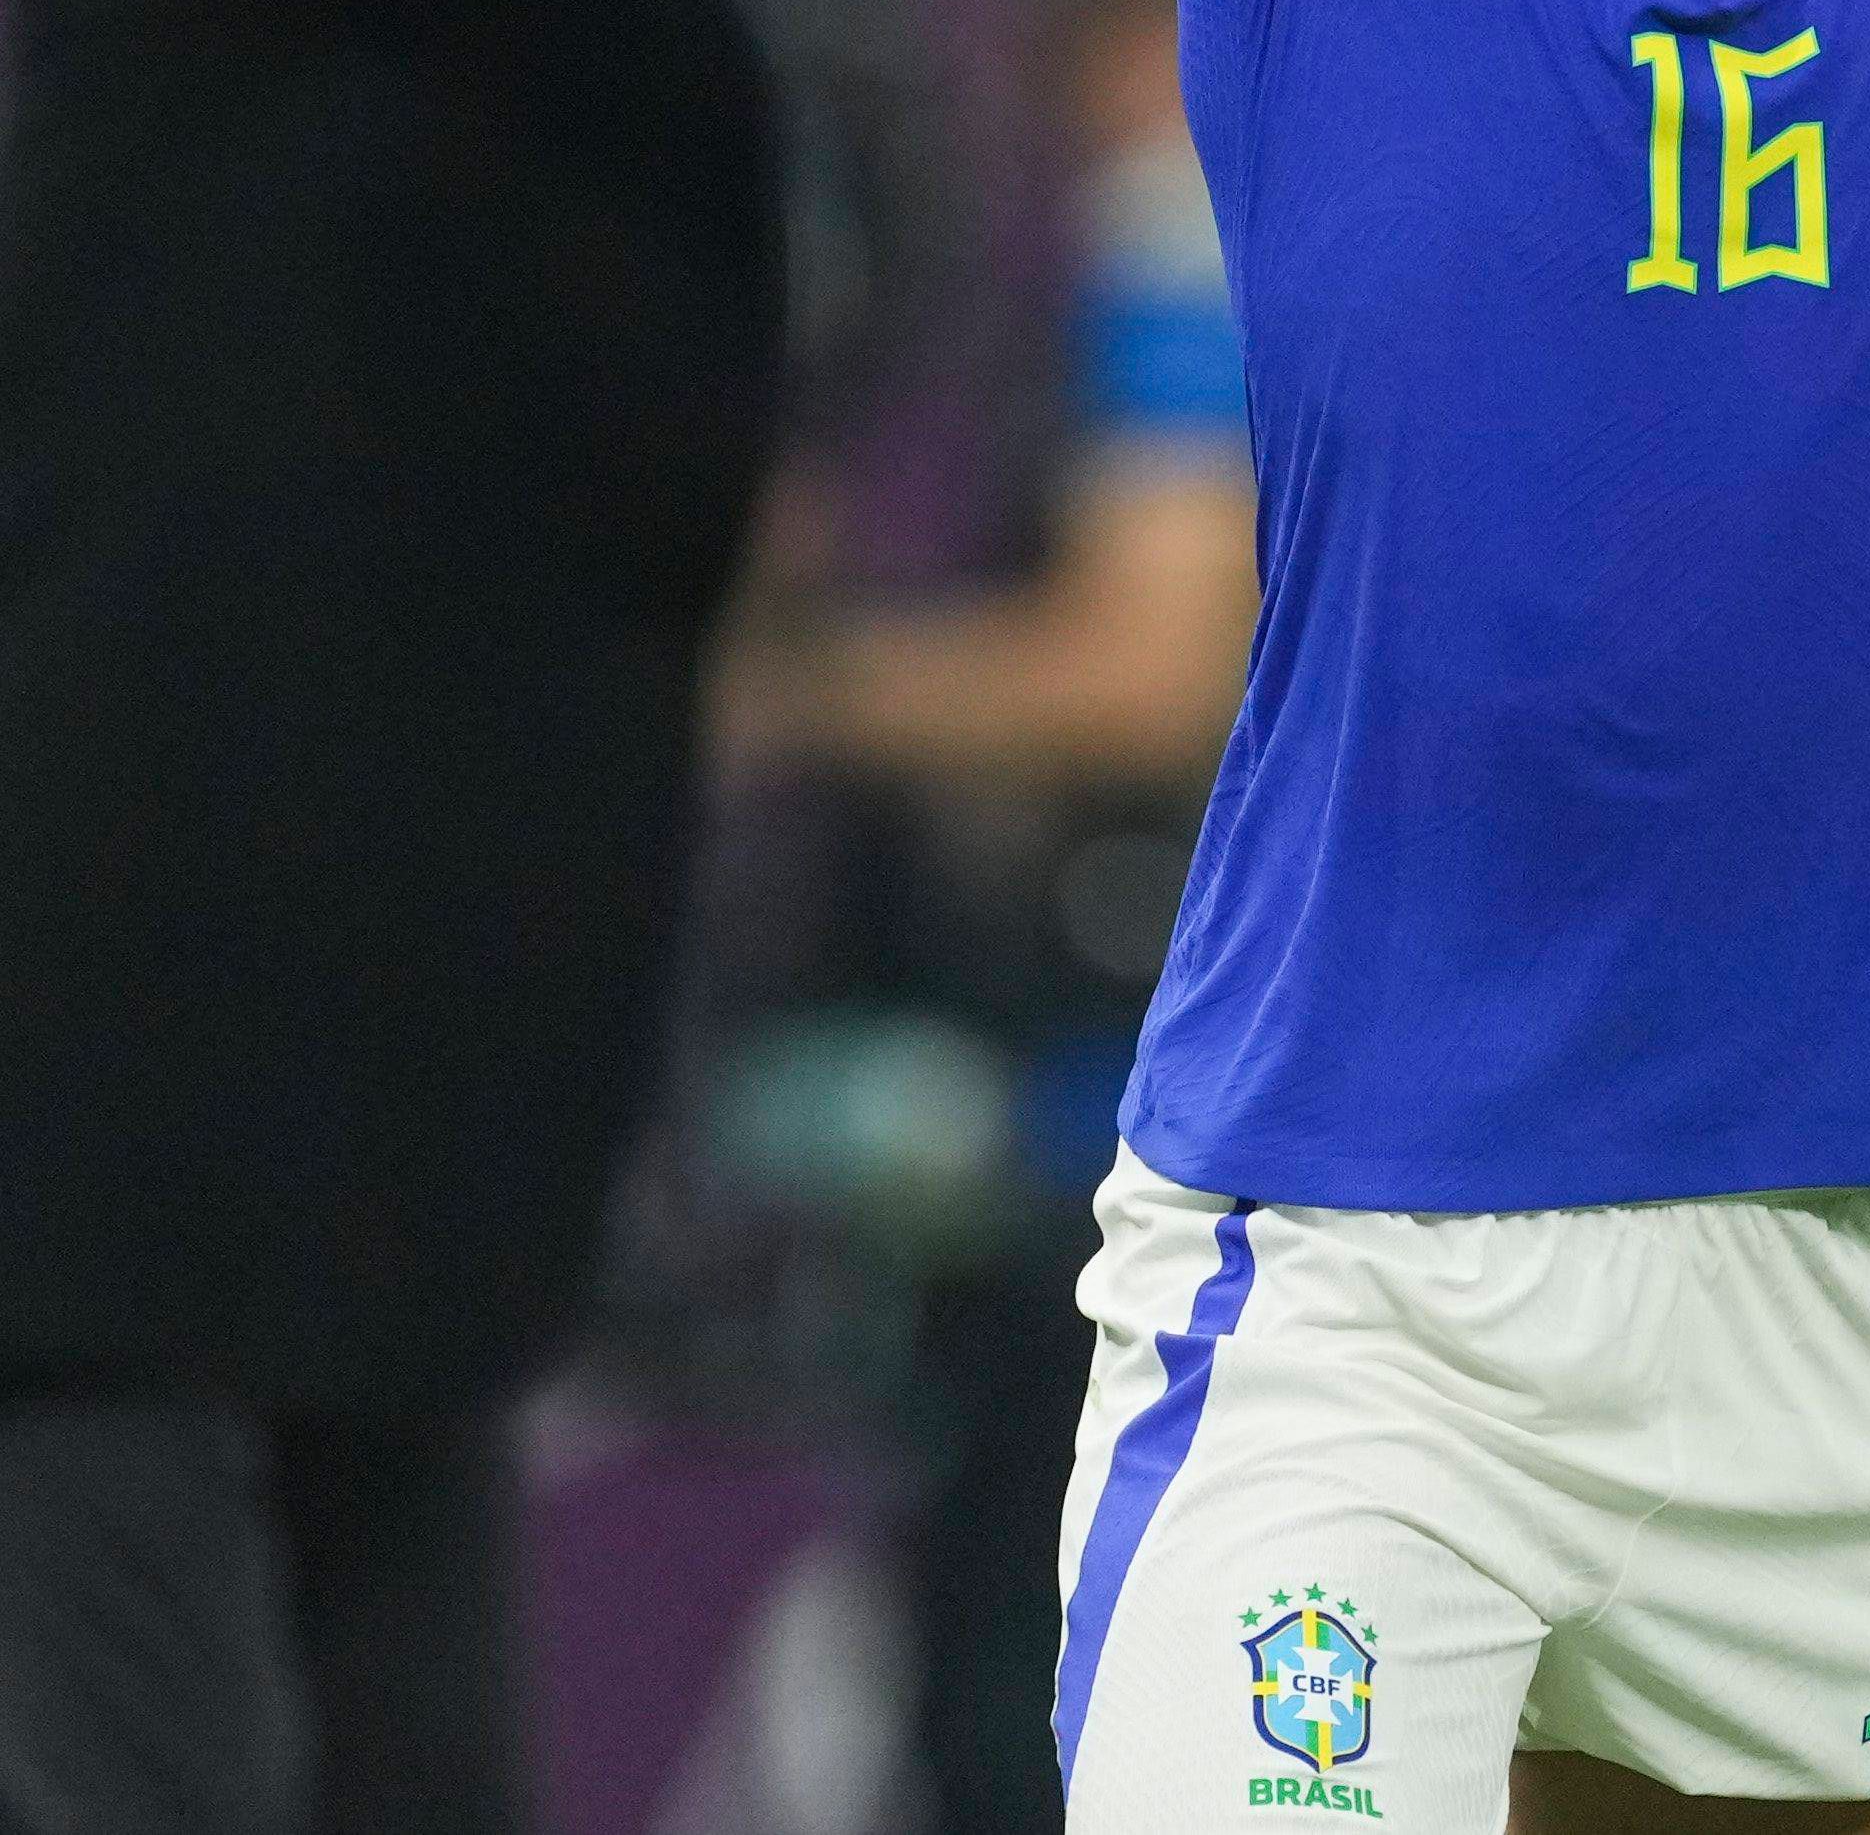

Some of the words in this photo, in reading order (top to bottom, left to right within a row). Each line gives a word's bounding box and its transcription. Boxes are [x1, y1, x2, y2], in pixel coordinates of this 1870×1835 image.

[1626, 27, 1830, 295] 16
[1292, 1674, 1341, 1696] CBF
[1249, 1777, 1383, 1819] BRASIL
